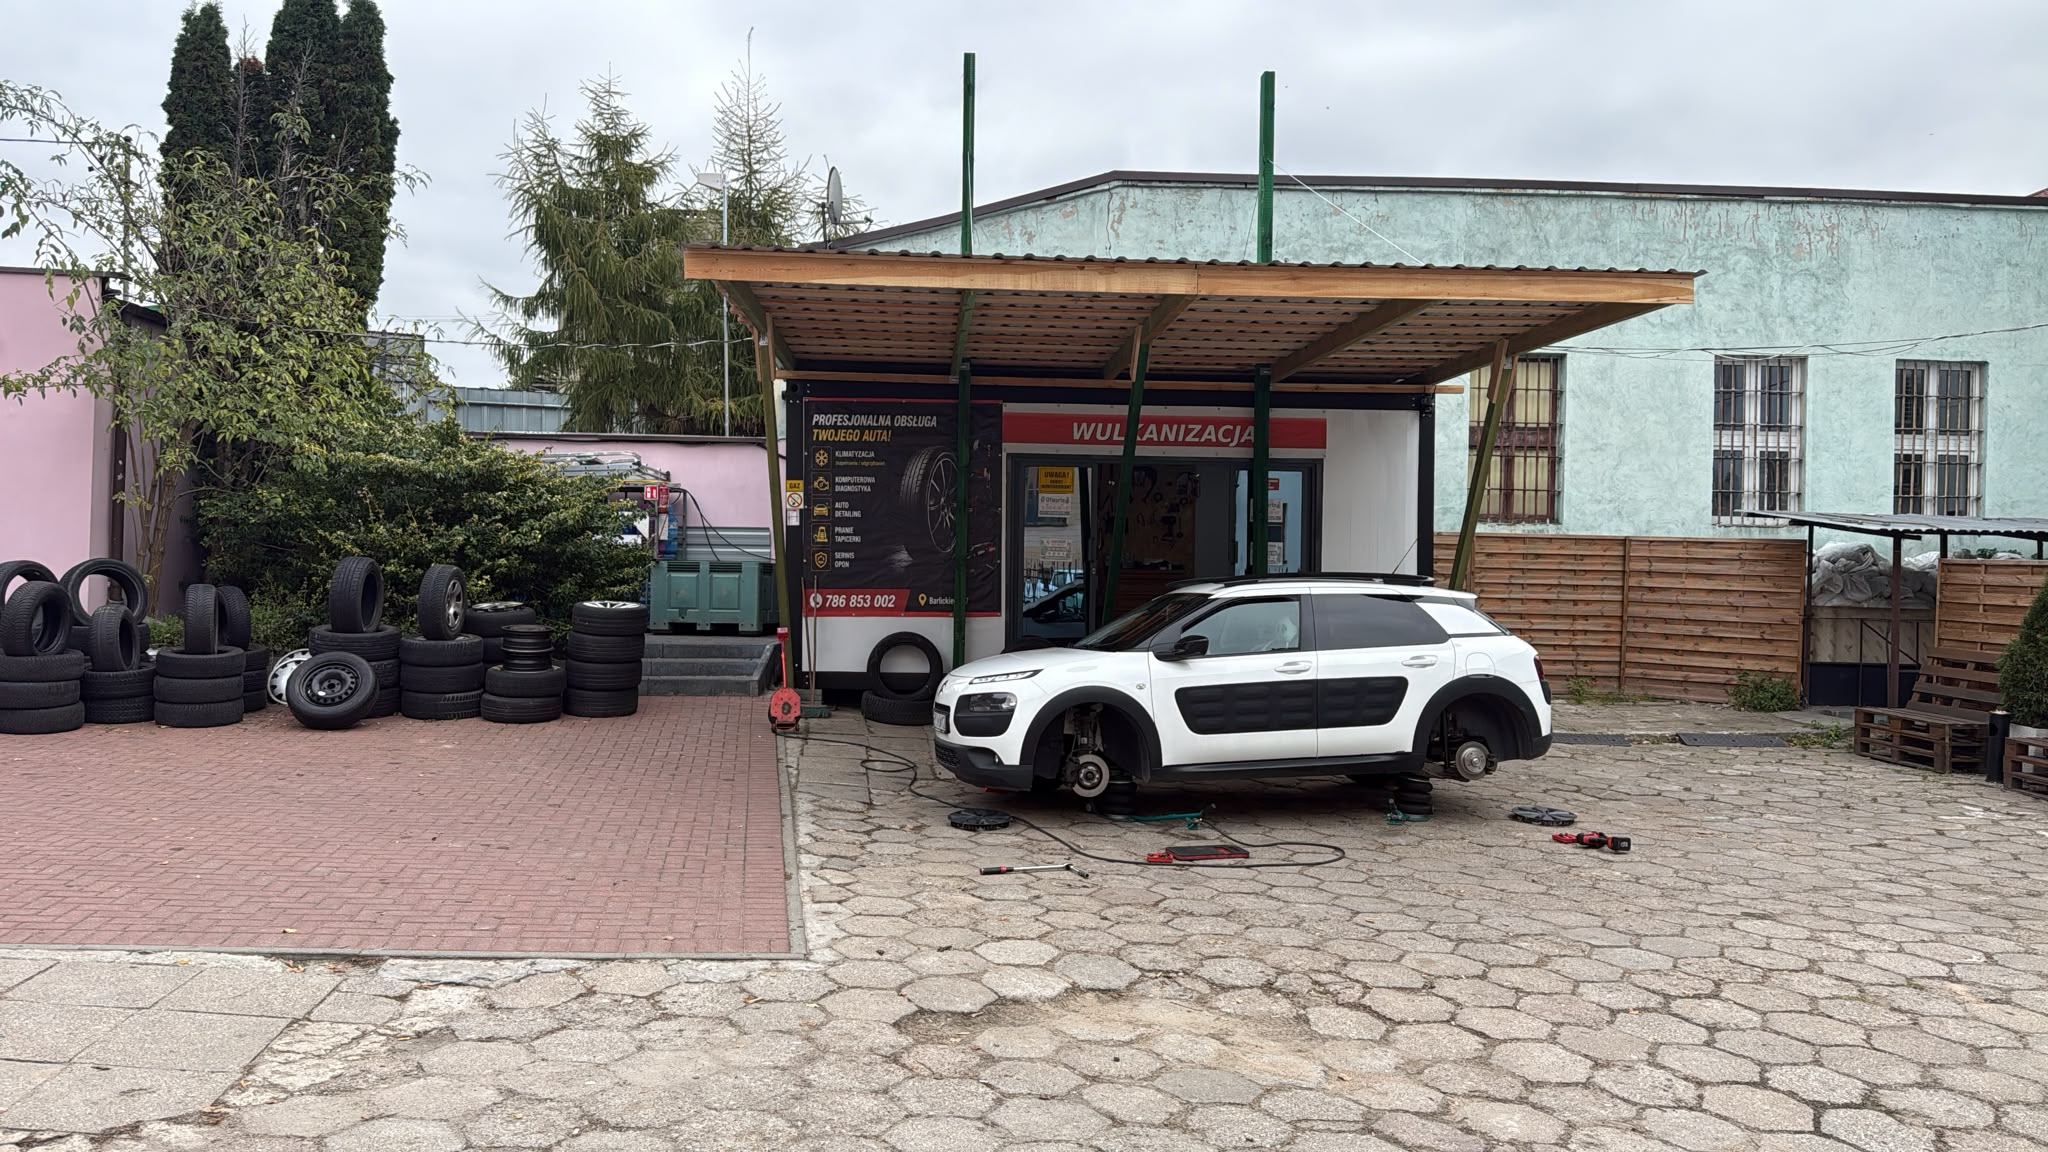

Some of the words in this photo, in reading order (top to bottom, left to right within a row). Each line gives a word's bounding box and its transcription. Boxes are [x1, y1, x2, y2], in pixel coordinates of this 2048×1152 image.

[812, 414, 891, 427] PROFESJONALNA
[894, 415, 937, 428] OBSŁUGA
[812, 429, 860, 441] TWOJEGO
[862, 430, 892, 442] AUTA!
[835, 450, 875, 458] KLIMATYZACJA
[835, 476, 876, 484] KOMPUTEROWA
[835, 485, 871, 493] DIAGNOSTYKA
[835, 501, 850, 509] AUTO
[835, 510, 862, 518] DETAILING
[835, 526, 854, 534] PRANIE
[835, 535, 861, 543] TAPICERKI
[825, 594, 847, 608] 786
[849, 594, 871, 608] 853
[873, 594, 896, 608] 002
[928, 596, 956, 605] Barlickie
